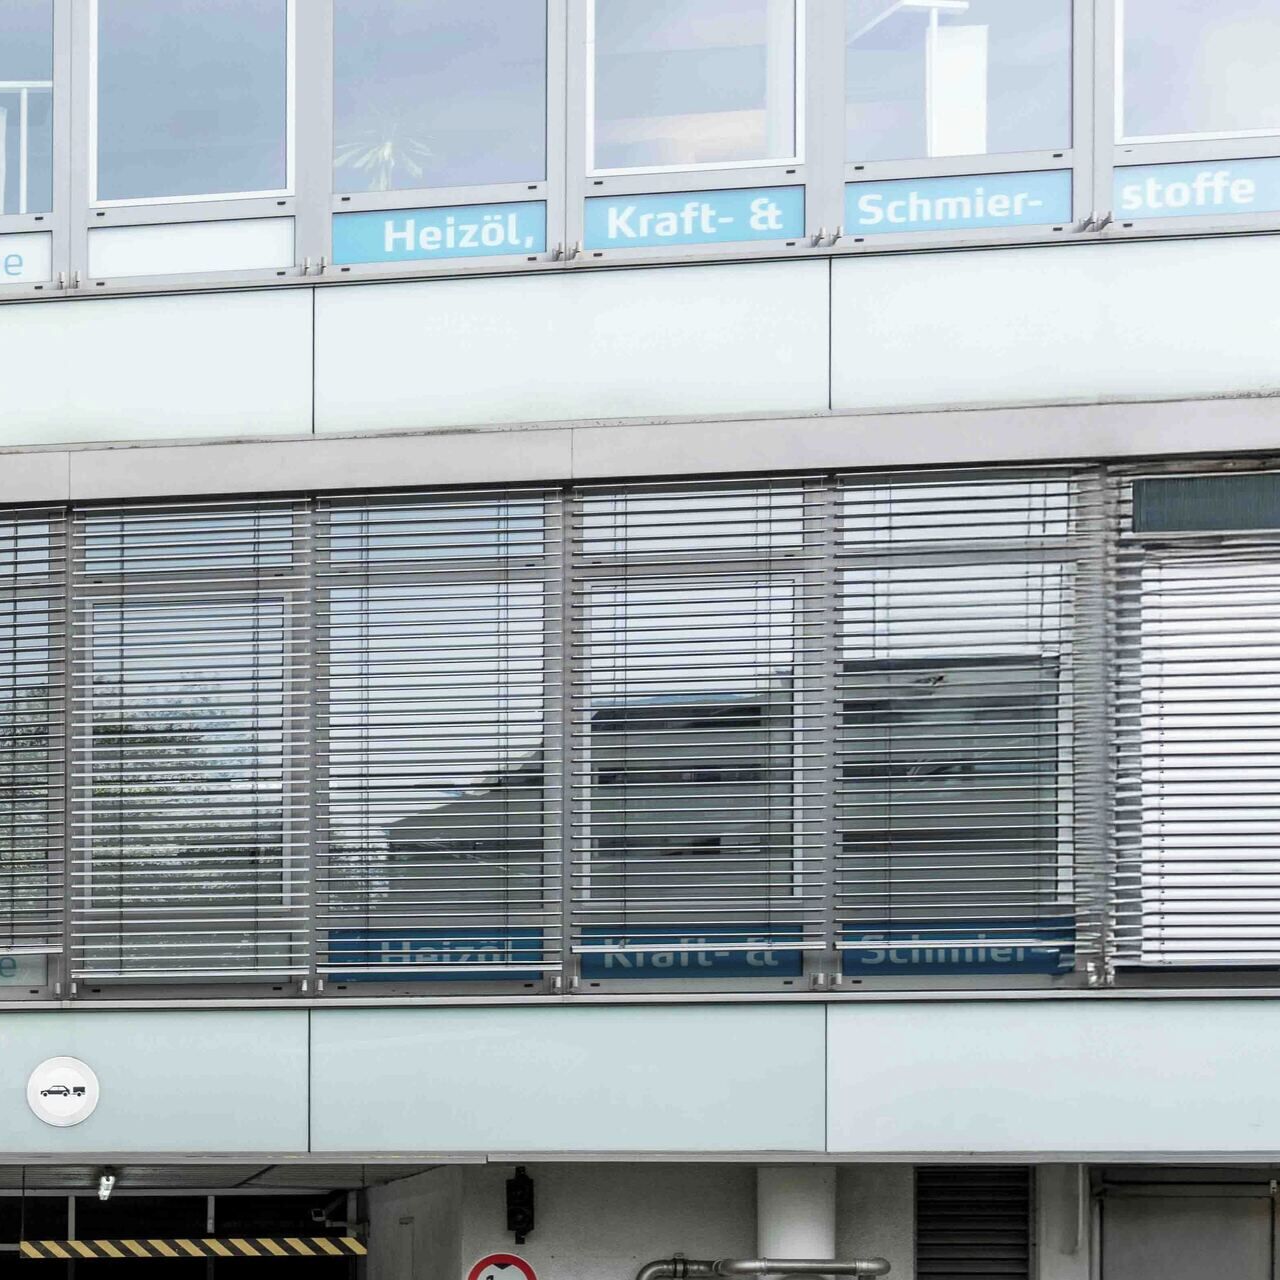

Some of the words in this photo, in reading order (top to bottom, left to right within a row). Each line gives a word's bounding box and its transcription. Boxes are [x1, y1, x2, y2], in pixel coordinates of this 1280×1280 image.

[384, 210, 534, 253] Heizöl,
[607, 200, 734, 240] Kraft-
[750, 197, 783, 231] &
[857, 188, 1043, 226] Schmier-
[1121, 170, 1256, 212] stoffe
